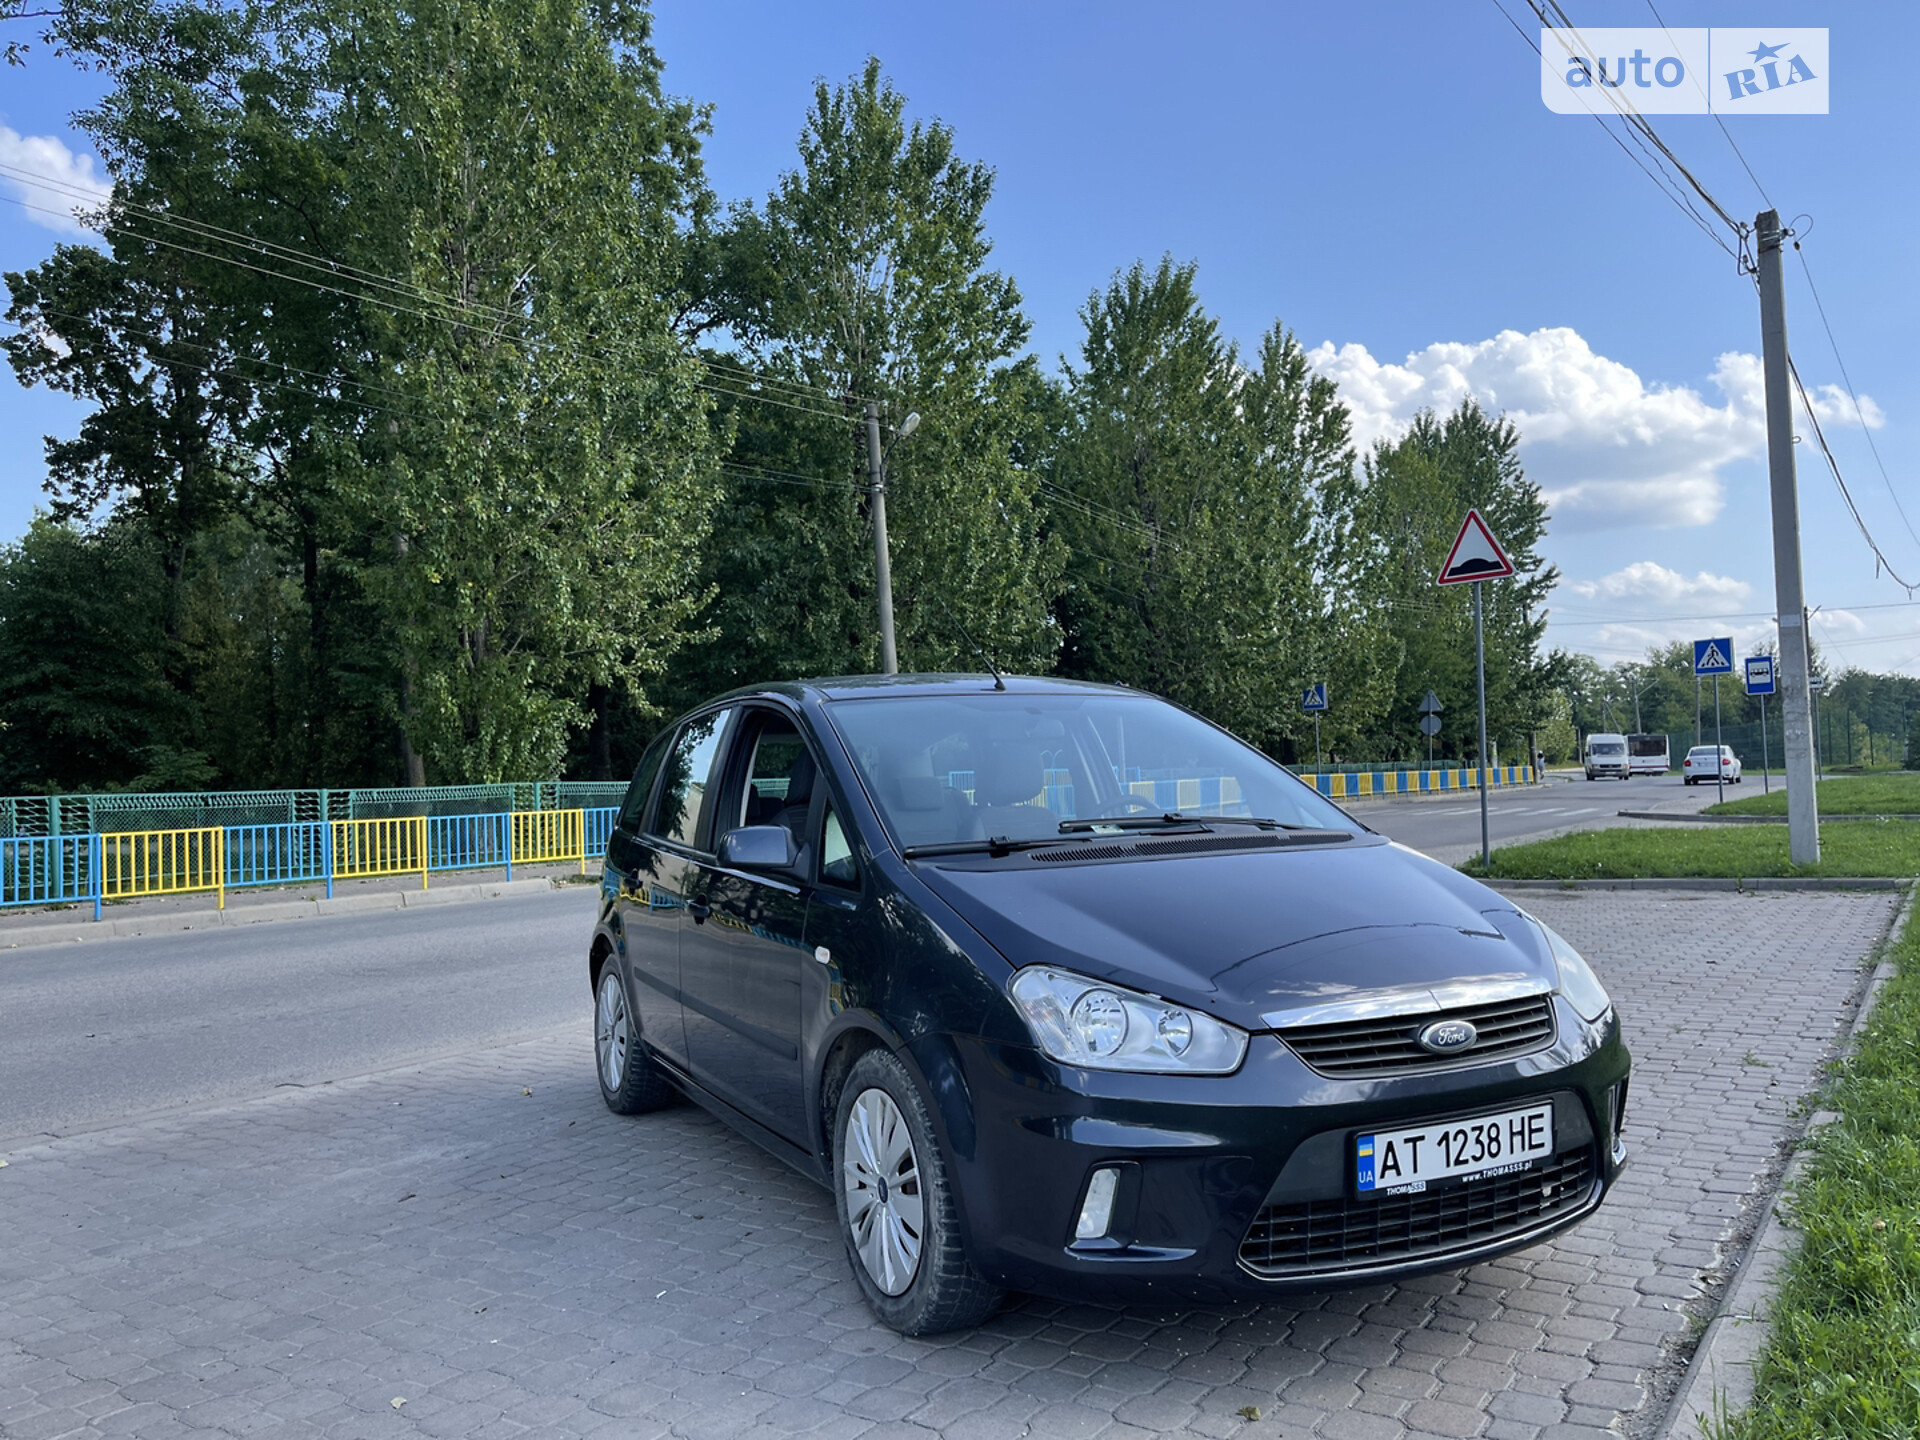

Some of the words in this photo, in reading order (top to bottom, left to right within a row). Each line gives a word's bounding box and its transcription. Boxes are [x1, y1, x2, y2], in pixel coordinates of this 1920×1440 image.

[1437, 1027, 1465, 1045] Ford
[1379, 1135, 1426, 1179] AT
[1436, 1122, 1501, 1168] 1238
[1509, 1113, 1545, 1155] HE
[1359, 1171, 1374, 1184] UA
[1461, 1161, 1532, 1183] www.THOMASSS.pl
